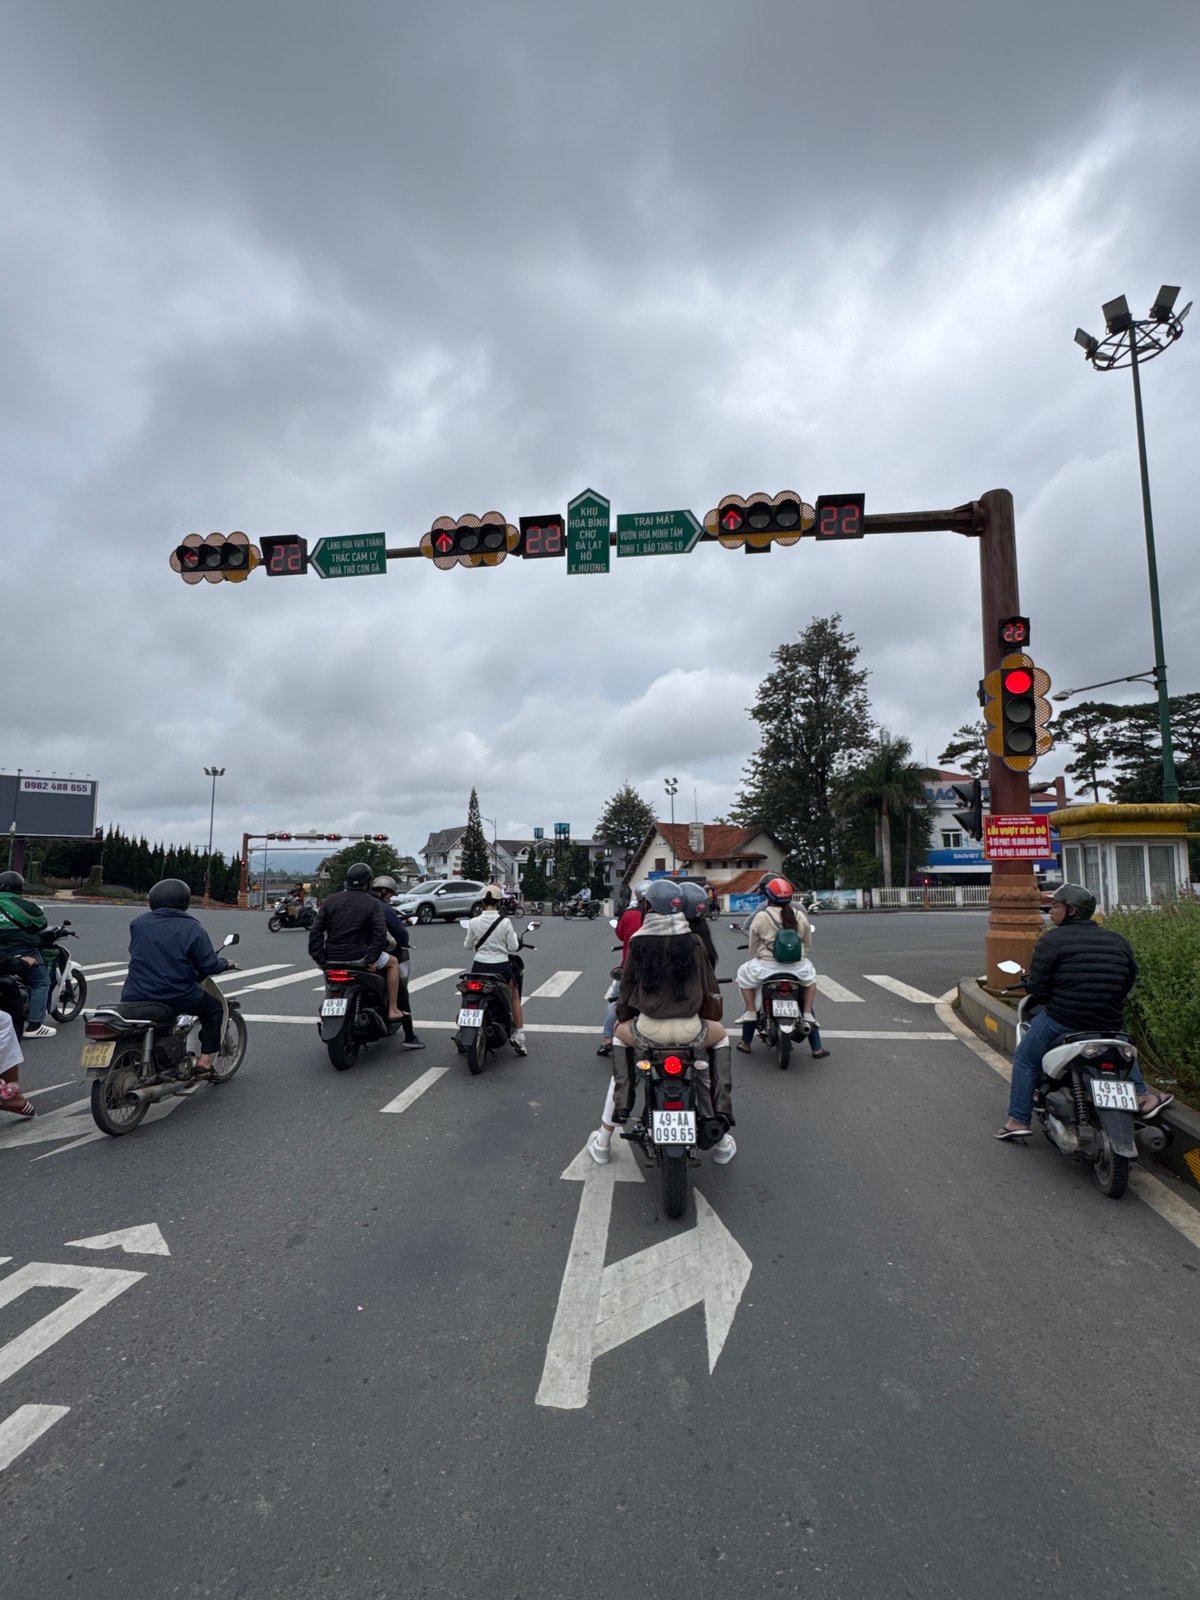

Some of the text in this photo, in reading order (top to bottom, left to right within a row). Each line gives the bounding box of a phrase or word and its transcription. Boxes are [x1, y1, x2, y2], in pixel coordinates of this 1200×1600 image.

[580, 506, 598, 517] KHU
[588, 515, 608, 528] BÌNH
[634, 513, 676, 528] TRẠI MÁT
[816, 504, 860, 536] 22
[526, 524, 561, 554] 22
[638, 529, 652, 540] HOA
[652, 528, 669, 539] MINH
[270, 543, 302, 572] 22
[331, 551, 378, 563] THÁC CAM LY
[1003, 623, 1025, 641] 22
[24, 781, 88, 792] 0982 488 655
[1096, 1093, 1136, 1109] 371.01
[659, 1112, 689, 1126] 49-AA
[655, 1127, 694, 1141] 099.65
